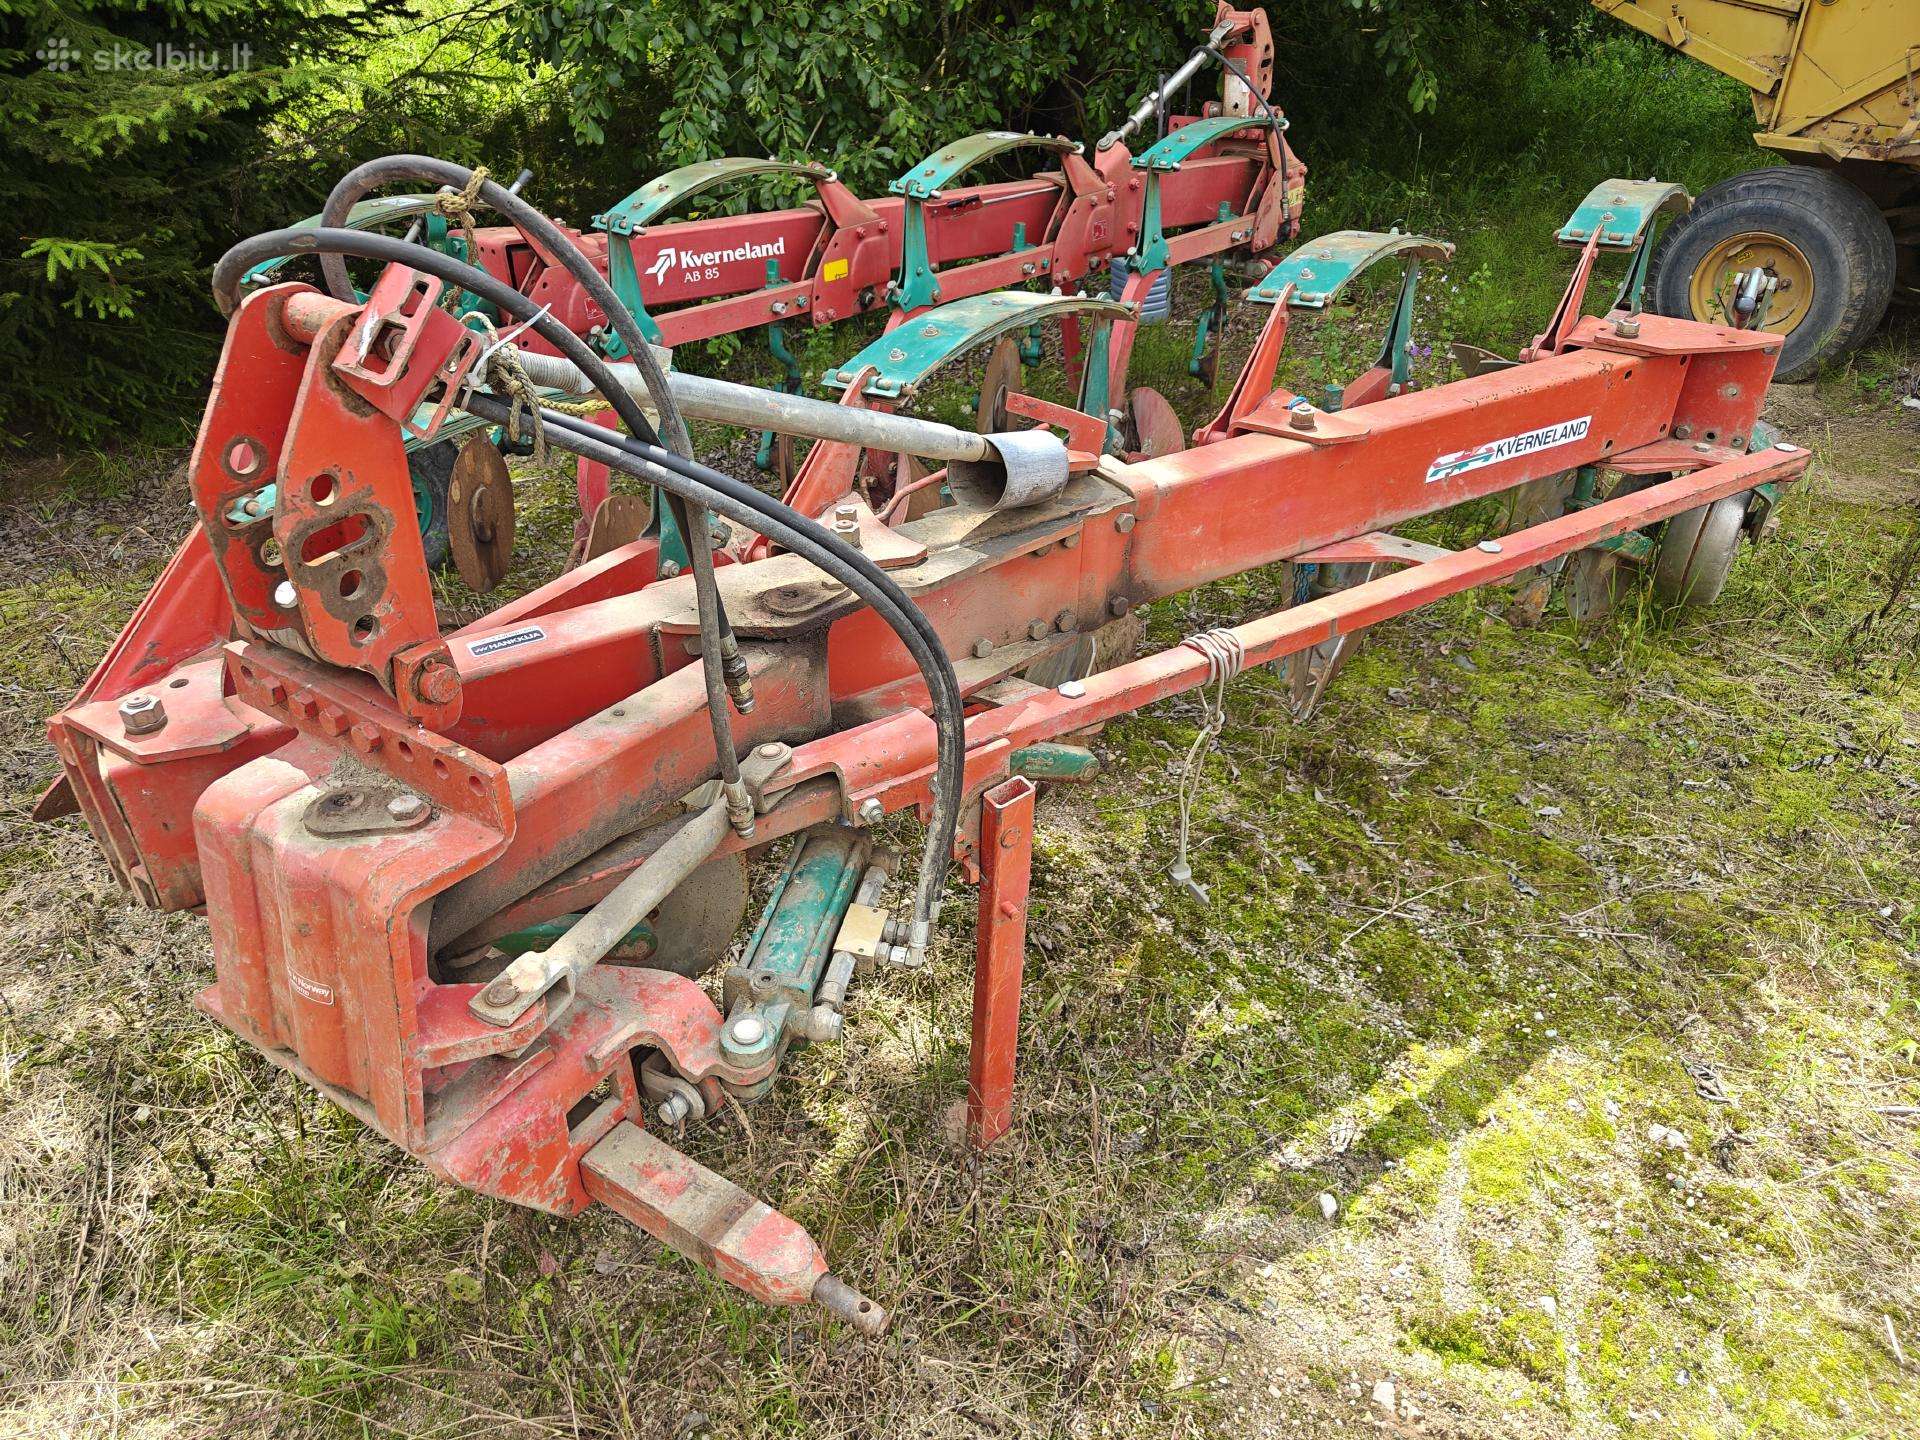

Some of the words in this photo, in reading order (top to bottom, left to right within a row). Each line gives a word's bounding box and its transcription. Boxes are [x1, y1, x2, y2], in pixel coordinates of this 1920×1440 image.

[680, 237, 785, 268] Kverneland
[684, 271, 701, 284] AB
[705, 268, 720, 279] 85
[1495, 421, 1588, 458] KVERNELAND
